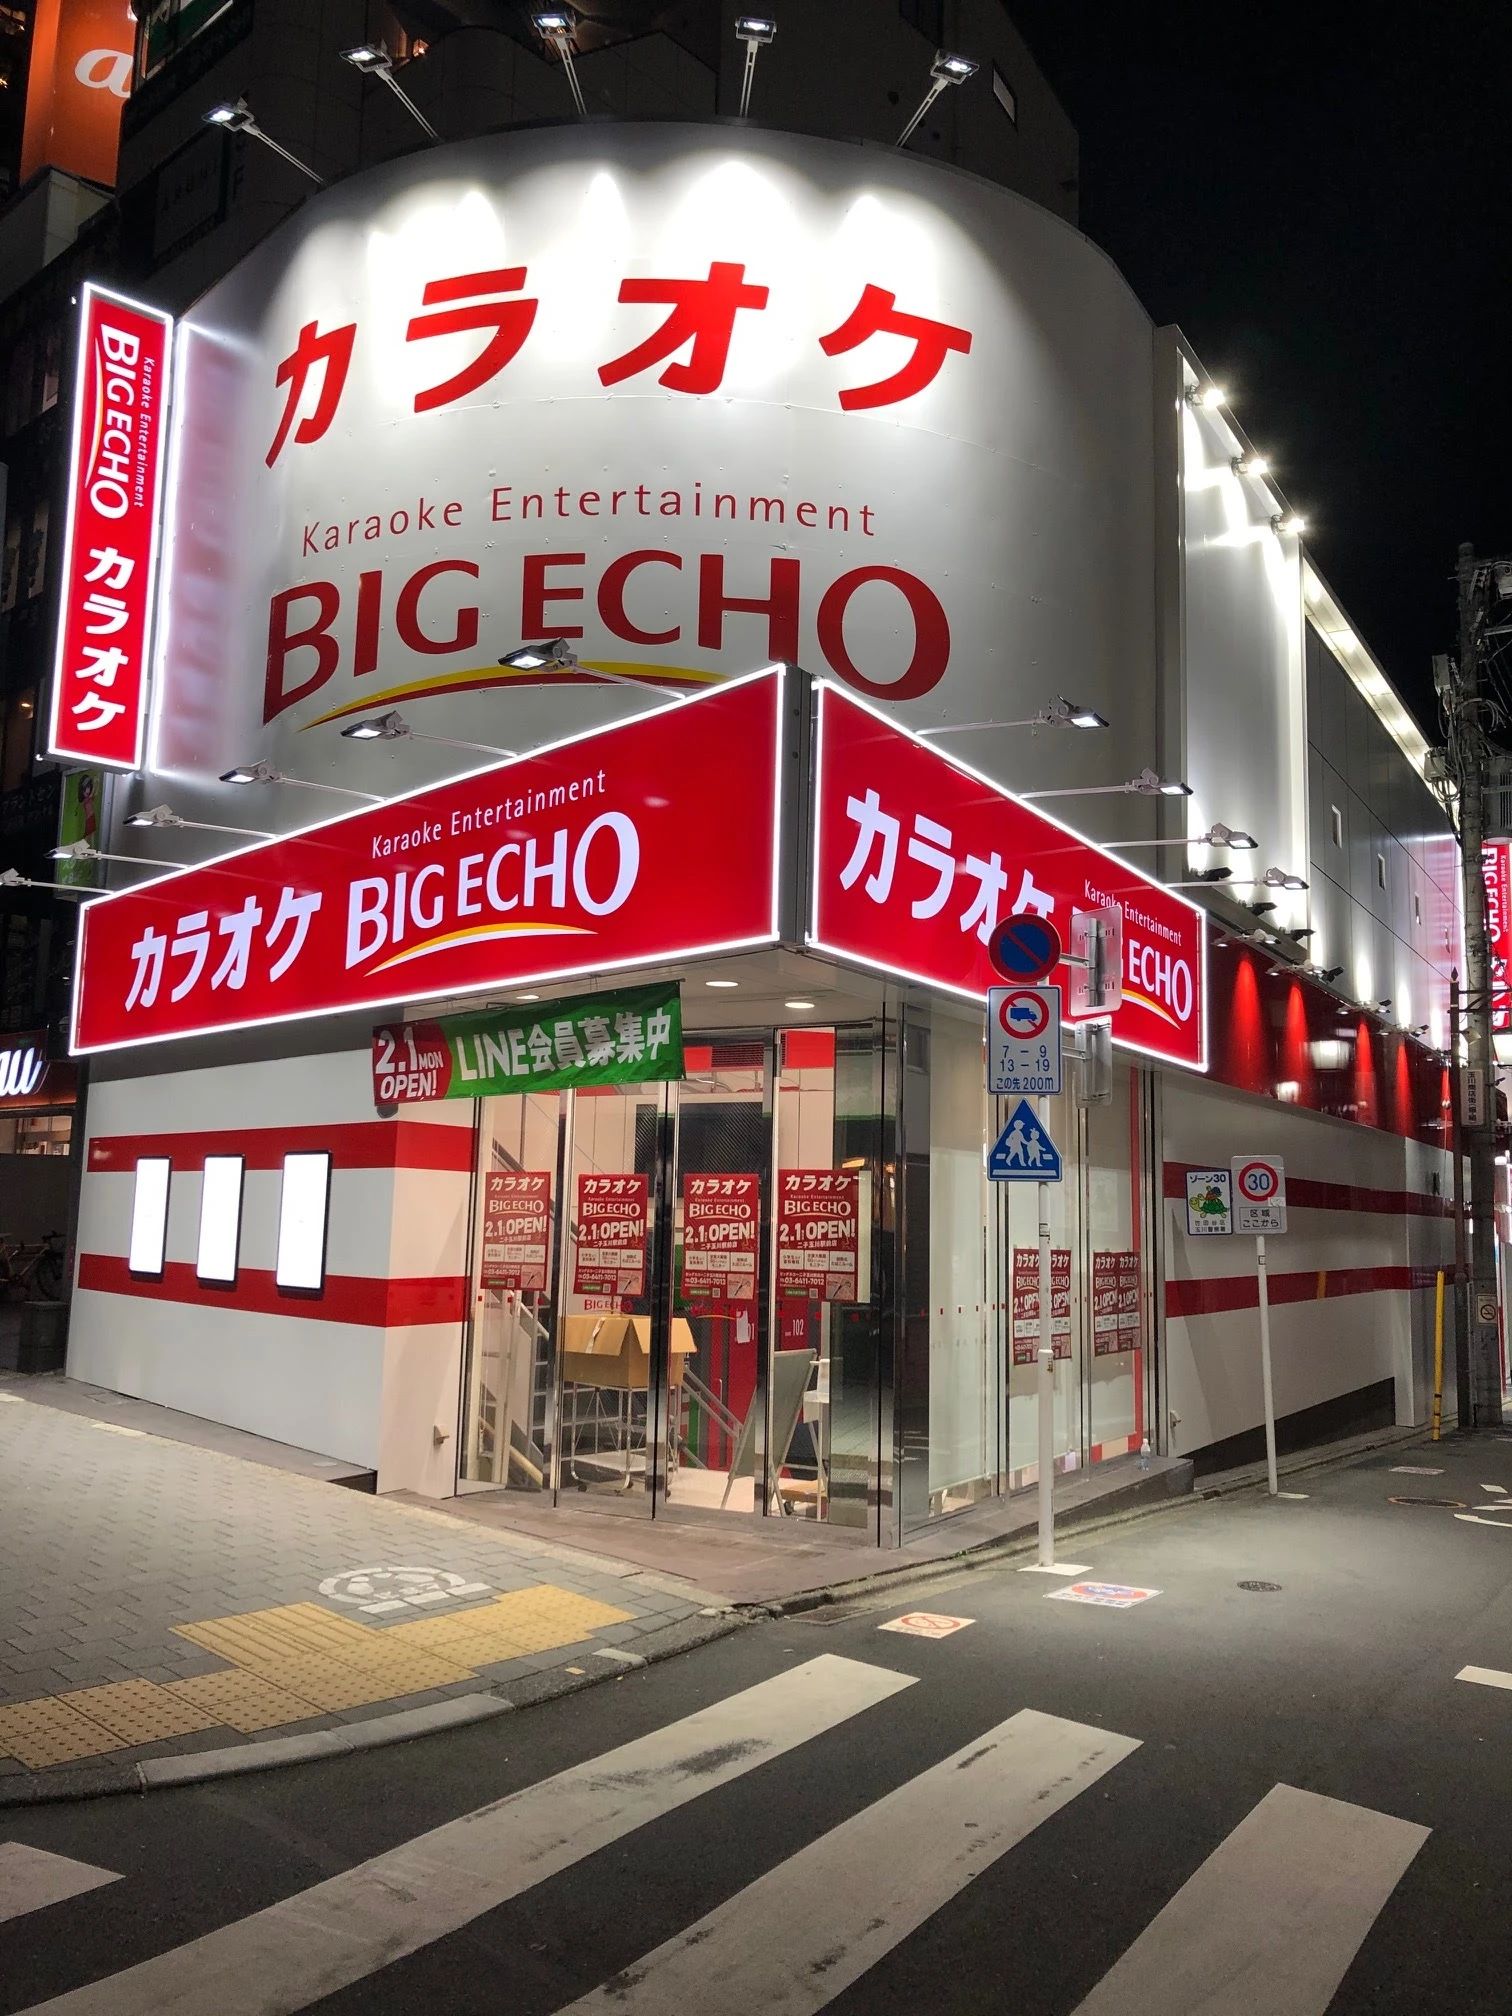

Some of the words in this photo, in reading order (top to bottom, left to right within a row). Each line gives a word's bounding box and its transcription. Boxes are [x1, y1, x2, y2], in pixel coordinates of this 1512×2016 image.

[101, 323, 140, 406] BIG
[264, 261, 972, 469] カラオケ
[142, 357, 155, 408] Karaoke
[90, 415, 133, 520] ECHO
[134, 412, 149, 508] Entertainment
[301, 496, 463, 557] Karaoke
[491, 481, 877, 537] Entertainment
[71, 547, 135, 732] カラオケ
[262, 559, 479, 726] BIG
[521, 549, 951, 701] ECHO
[372, 821, 442, 859] Karaoke
[451, 769, 606, 836] Entertainment
[345, 864, 445, 970] BIG
[458, 811, 641, 917] ECHO
[1124, 900, 1182, 947] Entertainment
[125, 887, 322, 1013] カラオケ
[1129, 940, 1192, 1022] ECHO
[375, 1027, 418, 1075] 2.1
[418, 1051, 444, 1069] MON
[455, 1007, 671, 1081] LINE会員募集中
[379, 1072, 437, 1100] OPEN!
[490, 1176, 545, 1192] カラオケ
[583, 1179, 642, 1195] カラオケ
[691, 1179, 752, 1195] カラオケ
[785, 1174, 852, 1191] カラオケ
[1248, 1172, 1270, 1191] 30
[489, 1199, 511, 1214] BIG
[512, 1200, 544, 1214] ECHO
[582, 1202, 607, 1217] BIG
[607, 1202, 641, 1217] ECHO
[689, 1203, 714, 1218] BIG
[715, 1204, 751, 1219] ECHO
[784, 1199, 811, 1216] BIG
[812, 1201, 851, 1216] ECHO
[505, 1215, 547, 1235] OPEN!
[600, 1218, 644, 1238] OPEN!
[708, 1220, 755, 1242] OPEN!
[805, 1219, 856, 1240] OPEN!
[1242, 1219, 1279, 1228] ここから
[793, 1319, 804, 1336] 102
